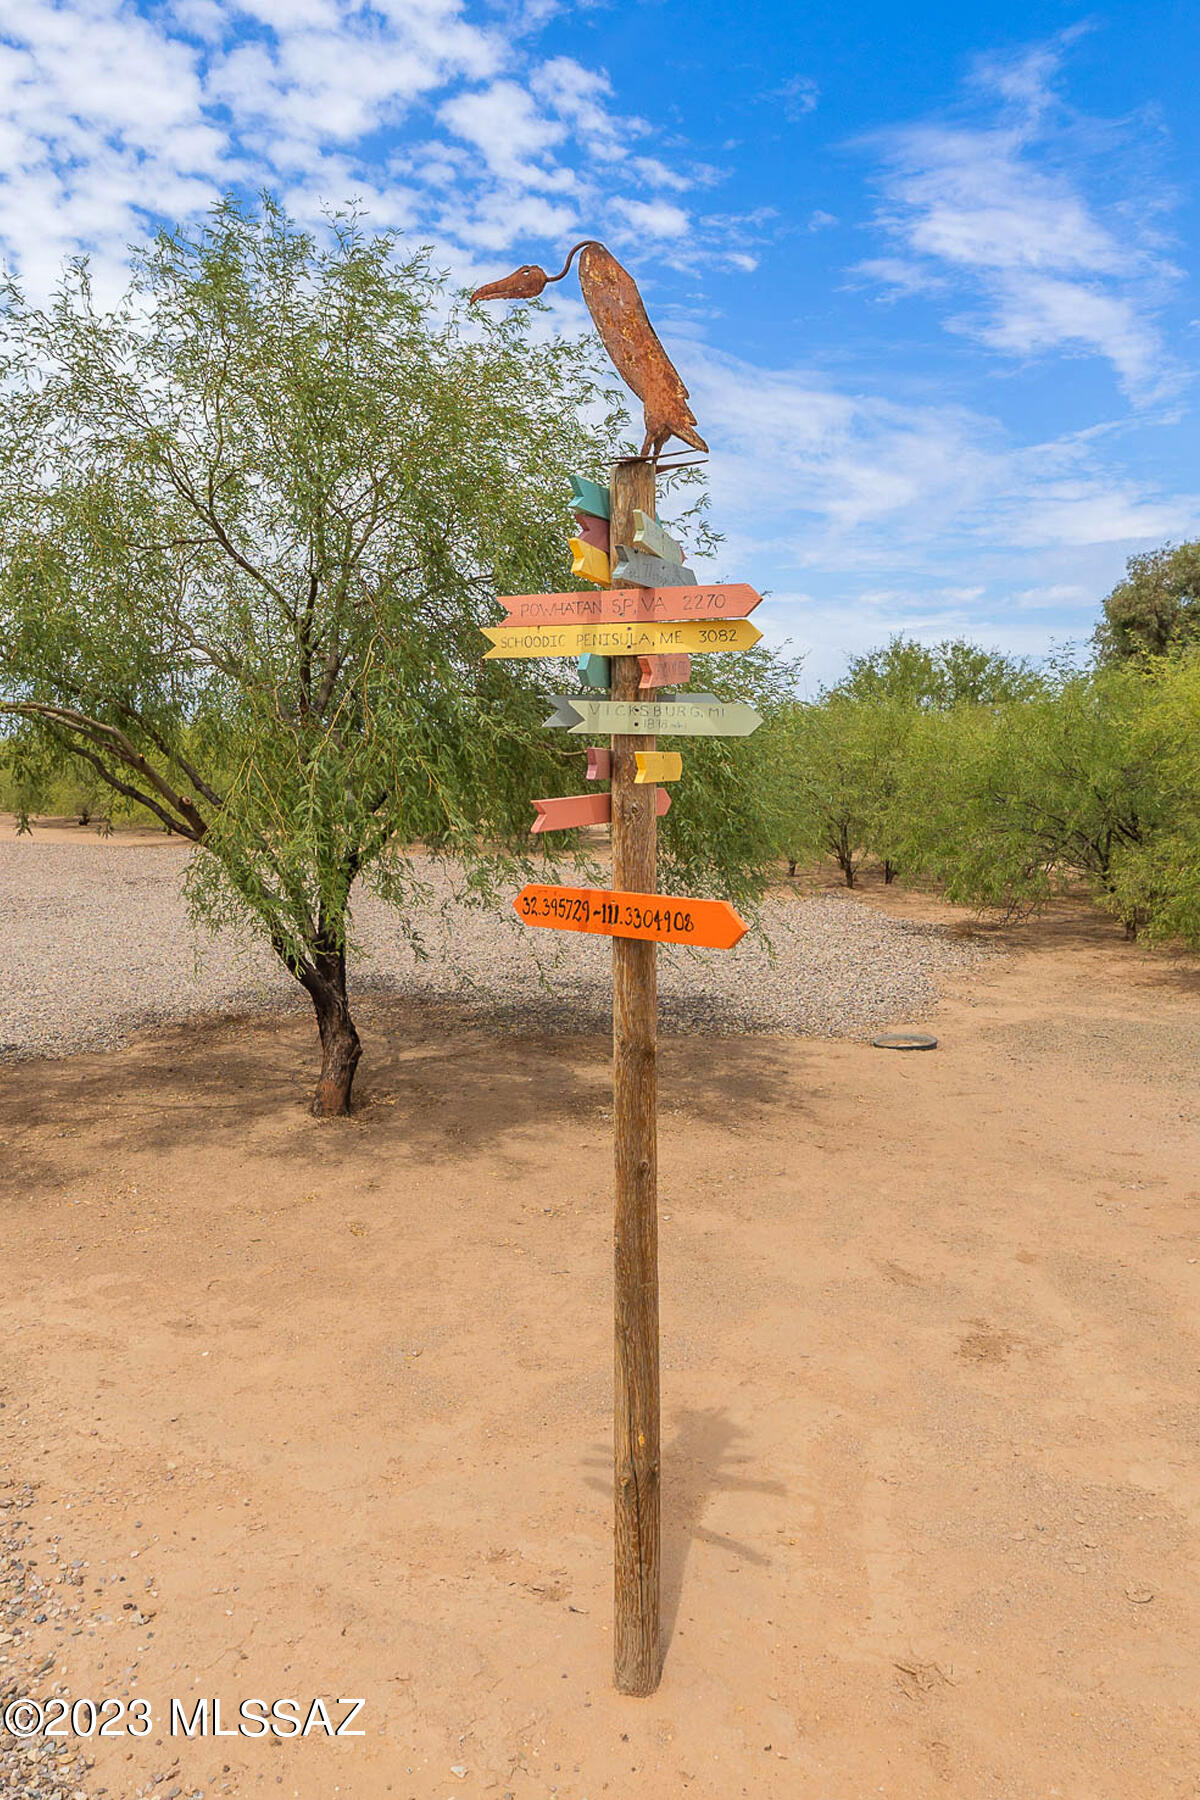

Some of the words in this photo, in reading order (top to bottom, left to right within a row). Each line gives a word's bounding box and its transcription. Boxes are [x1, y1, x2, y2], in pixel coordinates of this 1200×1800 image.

[520, 600, 602, 617] POWHATAN
[641, 597, 668, 613] VA
[682, 593, 727, 611] 2270
[500, 633, 567, 649] SCHOODIC
[660, 630, 684, 644] ME
[698, 629, 739, 644] 3082
[708, 706, 725, 719] MI
